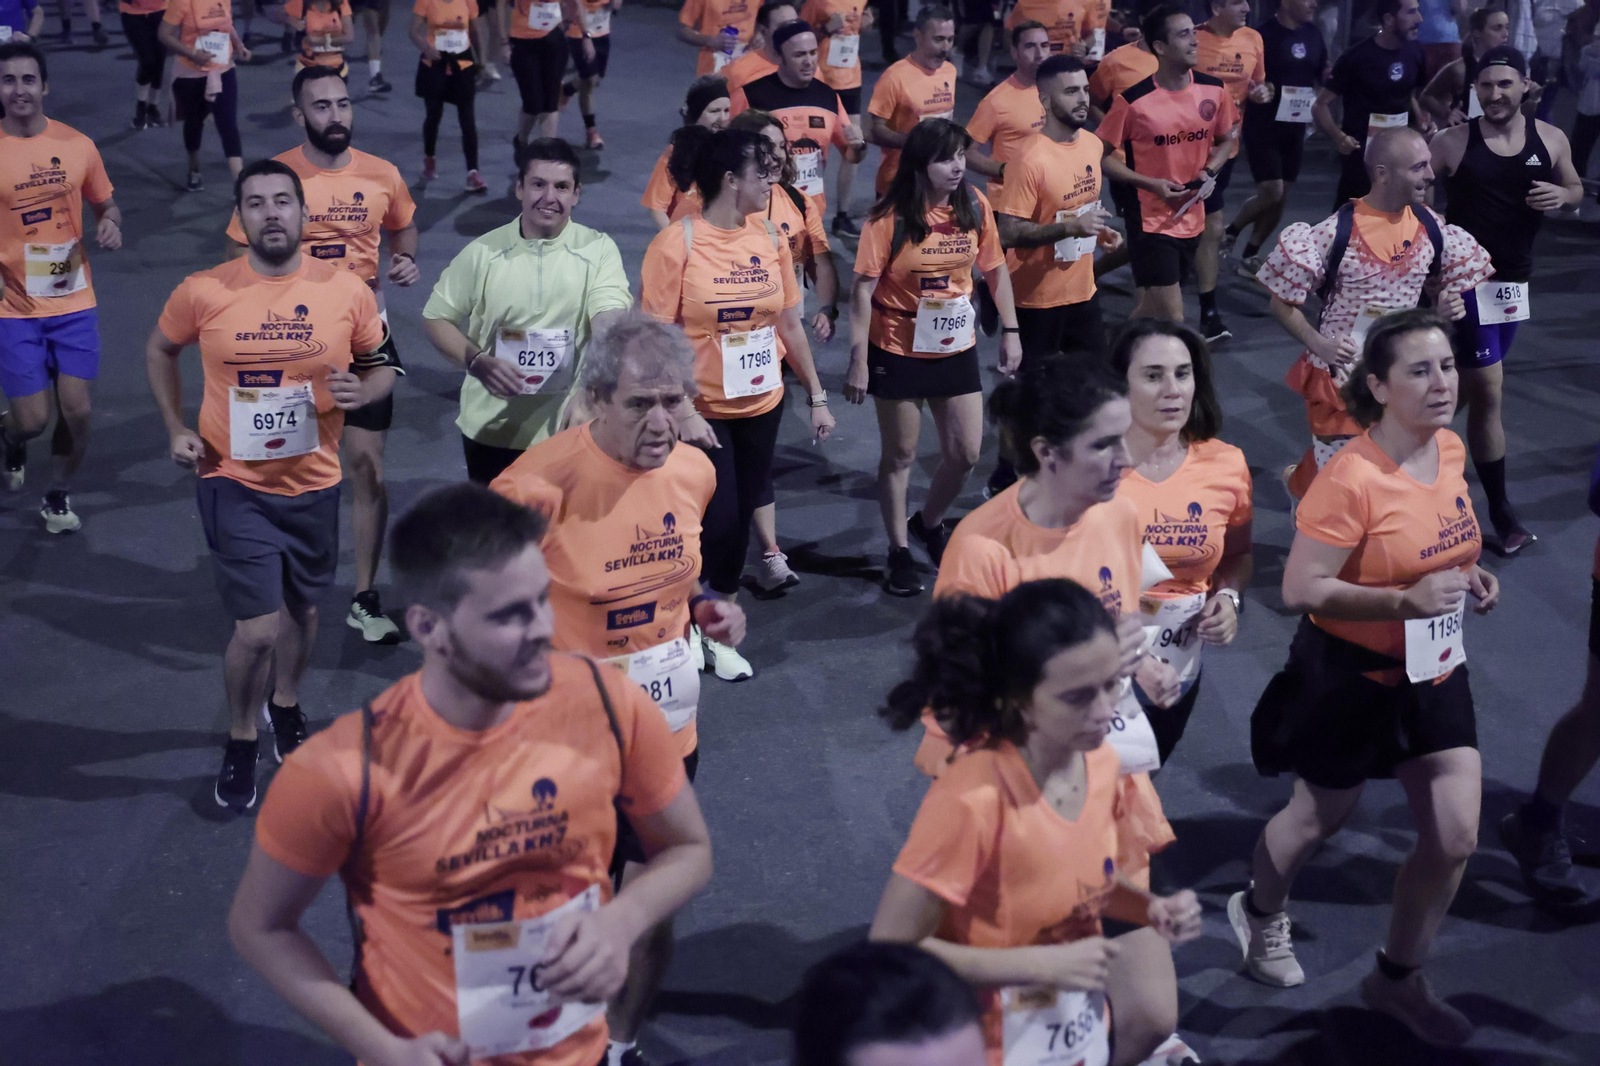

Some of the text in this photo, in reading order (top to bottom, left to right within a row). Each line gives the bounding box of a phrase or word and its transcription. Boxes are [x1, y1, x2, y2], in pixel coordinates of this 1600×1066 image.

[14, 175, 66, 191] SEVILLA KH7
[1063, 183, 1097, 201] SEVILLA KH7
[309, 213, 368, 222] SEVILLA KH7
[327, 206, 369, 214] NOCTURNA
[921, 245, 972, 255] SEVILLA KH7
[938, 239, 972, 247] NOCTURNA
[730, 268, 769, 277] NOCTURNA
[751, 273, 769, 283] KH7
[1495, 285, 1521, 301] 4518
[260, 322, 314, 331] NOCTURNA
[932, 314, 967, 331] 17966
[235, 331, 313, 341] SEVILLA KH7
[518, 350, 556, 367] 6213
[740, 348, 772, 370] 17968
[253, 410, 298, 431] 6974
[1144, 524, 1208, 534] NOCTURNA
[1438, 515, 1475, 541] NOCTURNA
[630, 535, 684, 554] NOCTURNA
[1141, 534, 1208, 547] ILLA KH7
[1420, 524, 1477, 560] SEVILLA KH7
[605, 545, 684, 573] SEVILLA KH7
[1153, 626, 1193, 648] 947
[640, 676, 672, 702] 81
[477, 810, 569, 842] NOCTURNA
[436, 825, 568, 874] SEVILLA KH7
